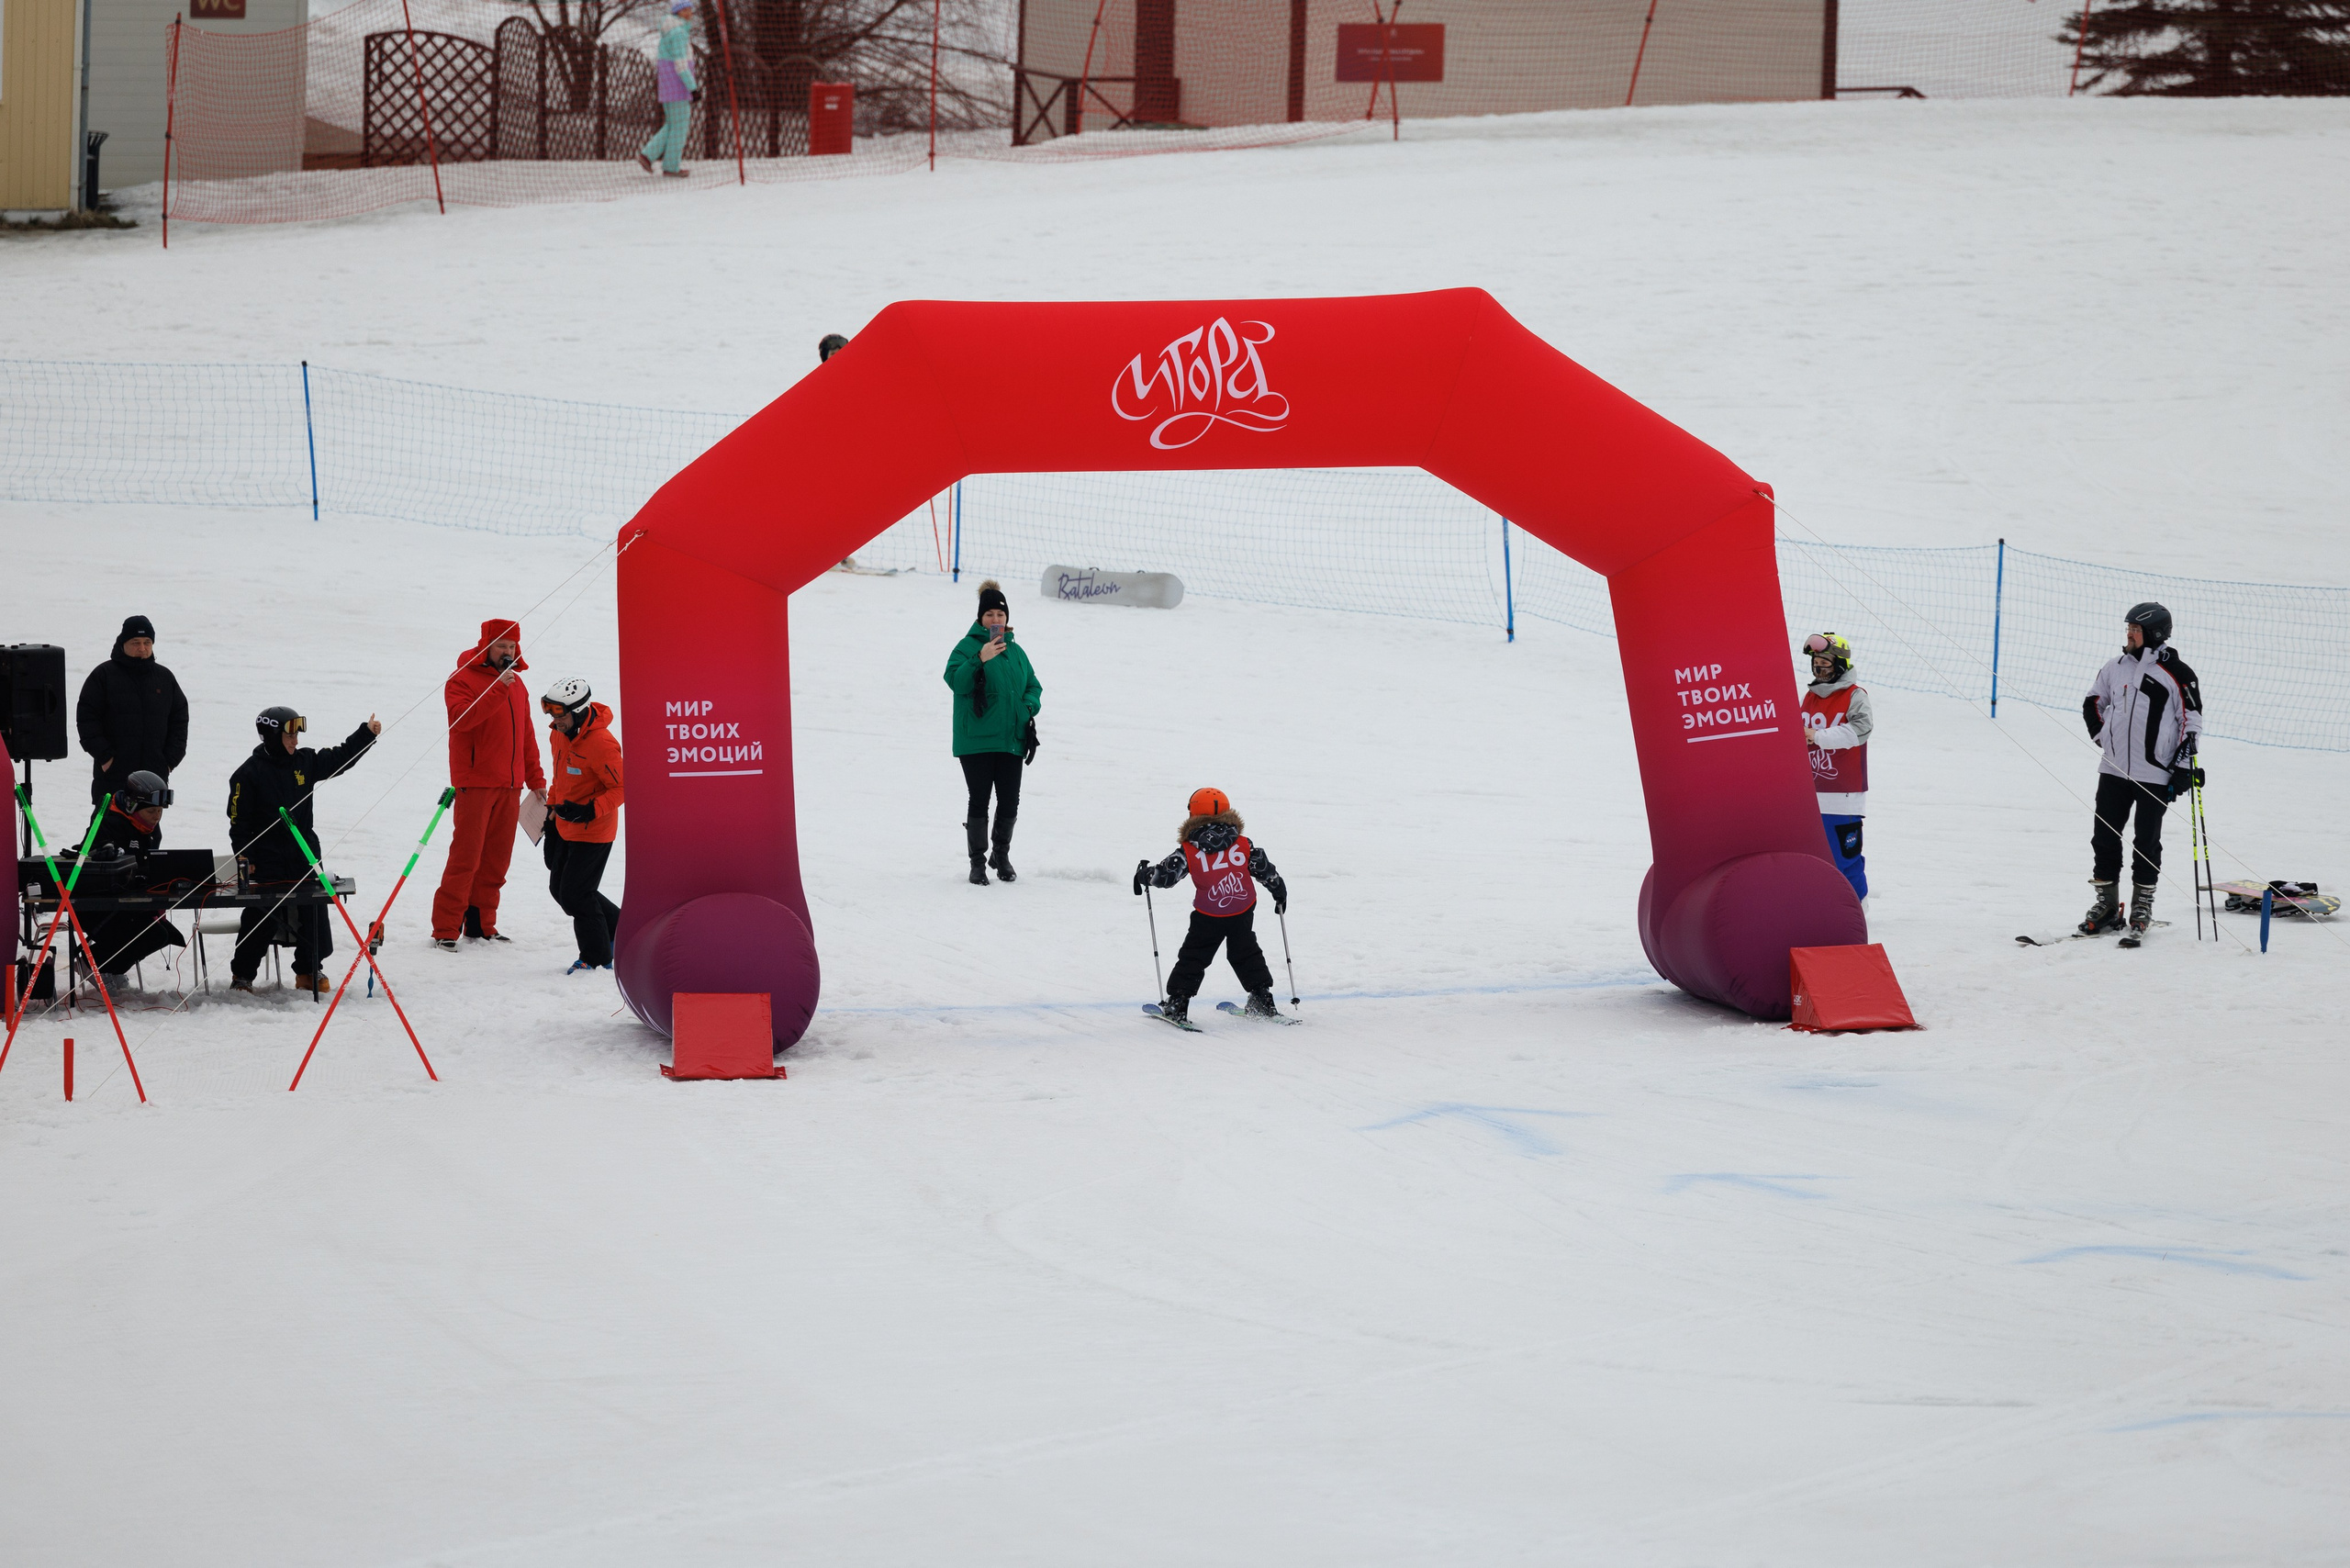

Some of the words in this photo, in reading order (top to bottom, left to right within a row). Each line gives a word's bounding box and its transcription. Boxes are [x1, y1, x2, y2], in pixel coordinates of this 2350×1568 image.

[1674, 664, 1722, 684] МИР
[1677, 683, 1751, 706] ТВОИХ
[666, 700, 713, 716] МИР
[1682, 700, 1776, 729] ЭМОЦИЙ
[666, 722, 740, 739] ТВОИХ
[666, 741, 763, 764] ЭМОЦИЙ
[230, 782, 241, 824] HEAD
[1195, 844, 1247, 873] 126
